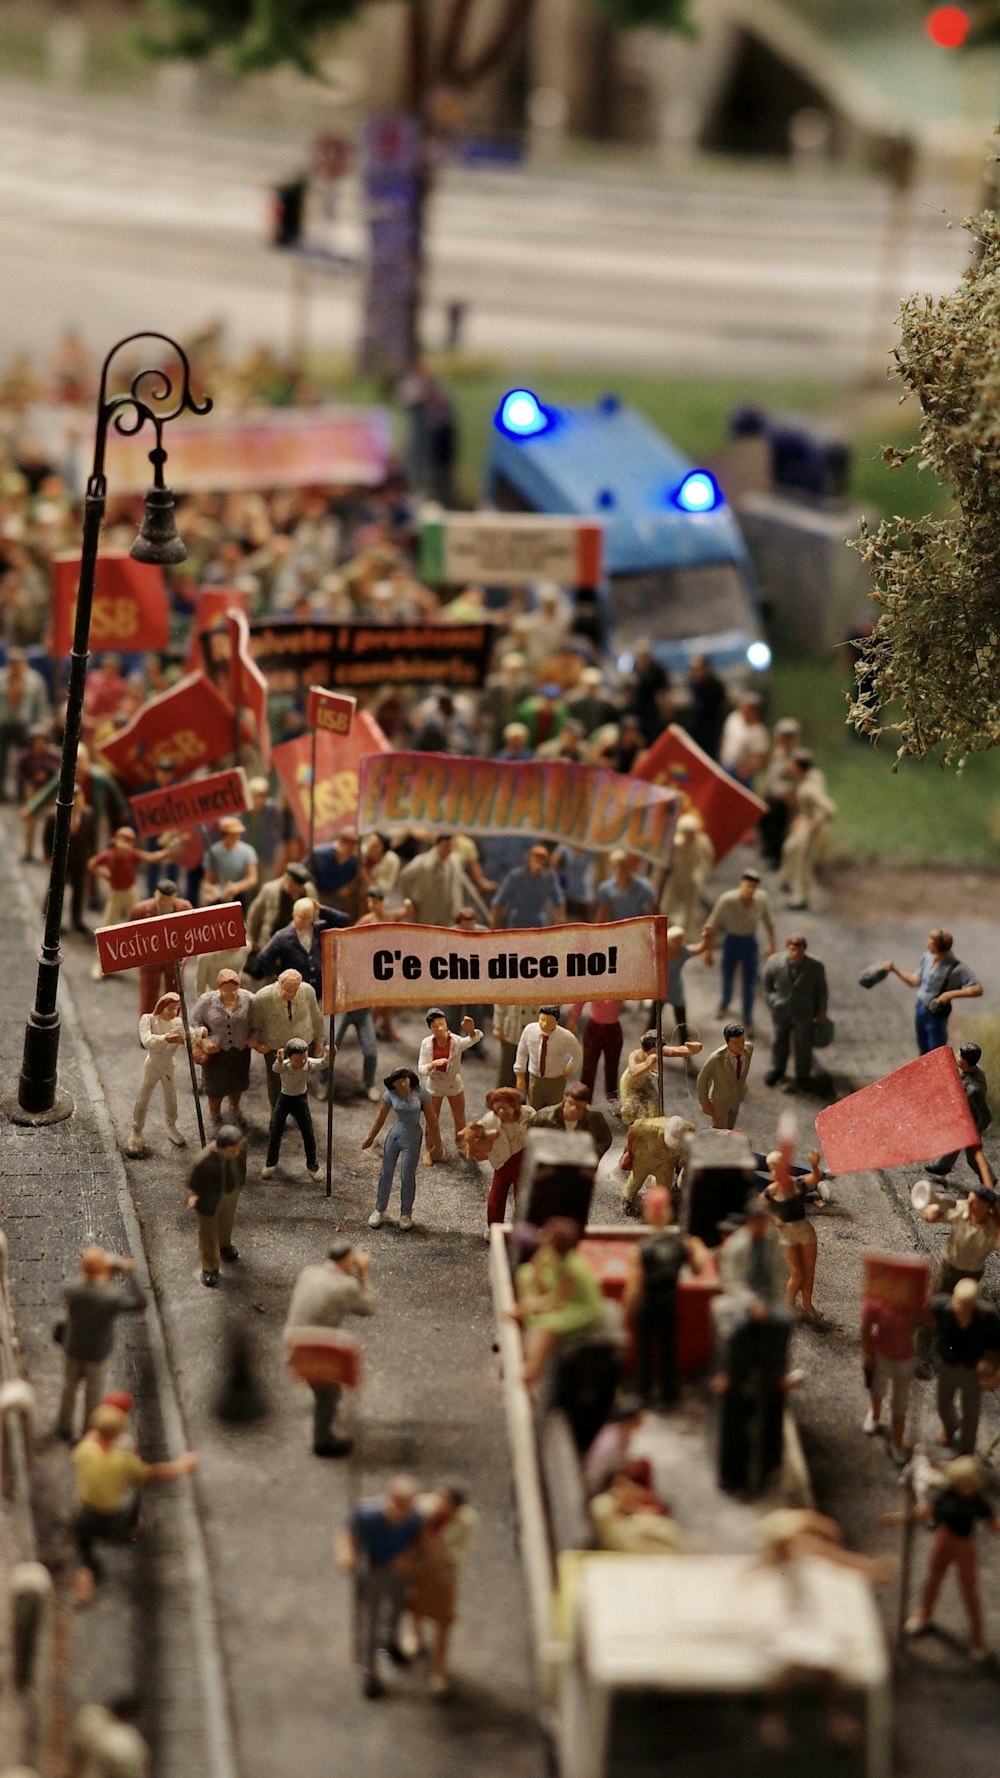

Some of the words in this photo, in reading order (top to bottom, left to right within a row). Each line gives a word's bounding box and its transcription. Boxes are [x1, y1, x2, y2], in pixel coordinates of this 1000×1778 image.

[317, 707, 348, 732] USB
[364, 757, 670, 855] FERMIAMOLI
[106, 931, 160, 961] Vostre
[164, 925, 179, 950] le
[373, 950, 421, 980] C'e
[429, 953, 480, 979] chi
[488, 953, 558, 979] dice
[566, 946, 617, 977] no!
